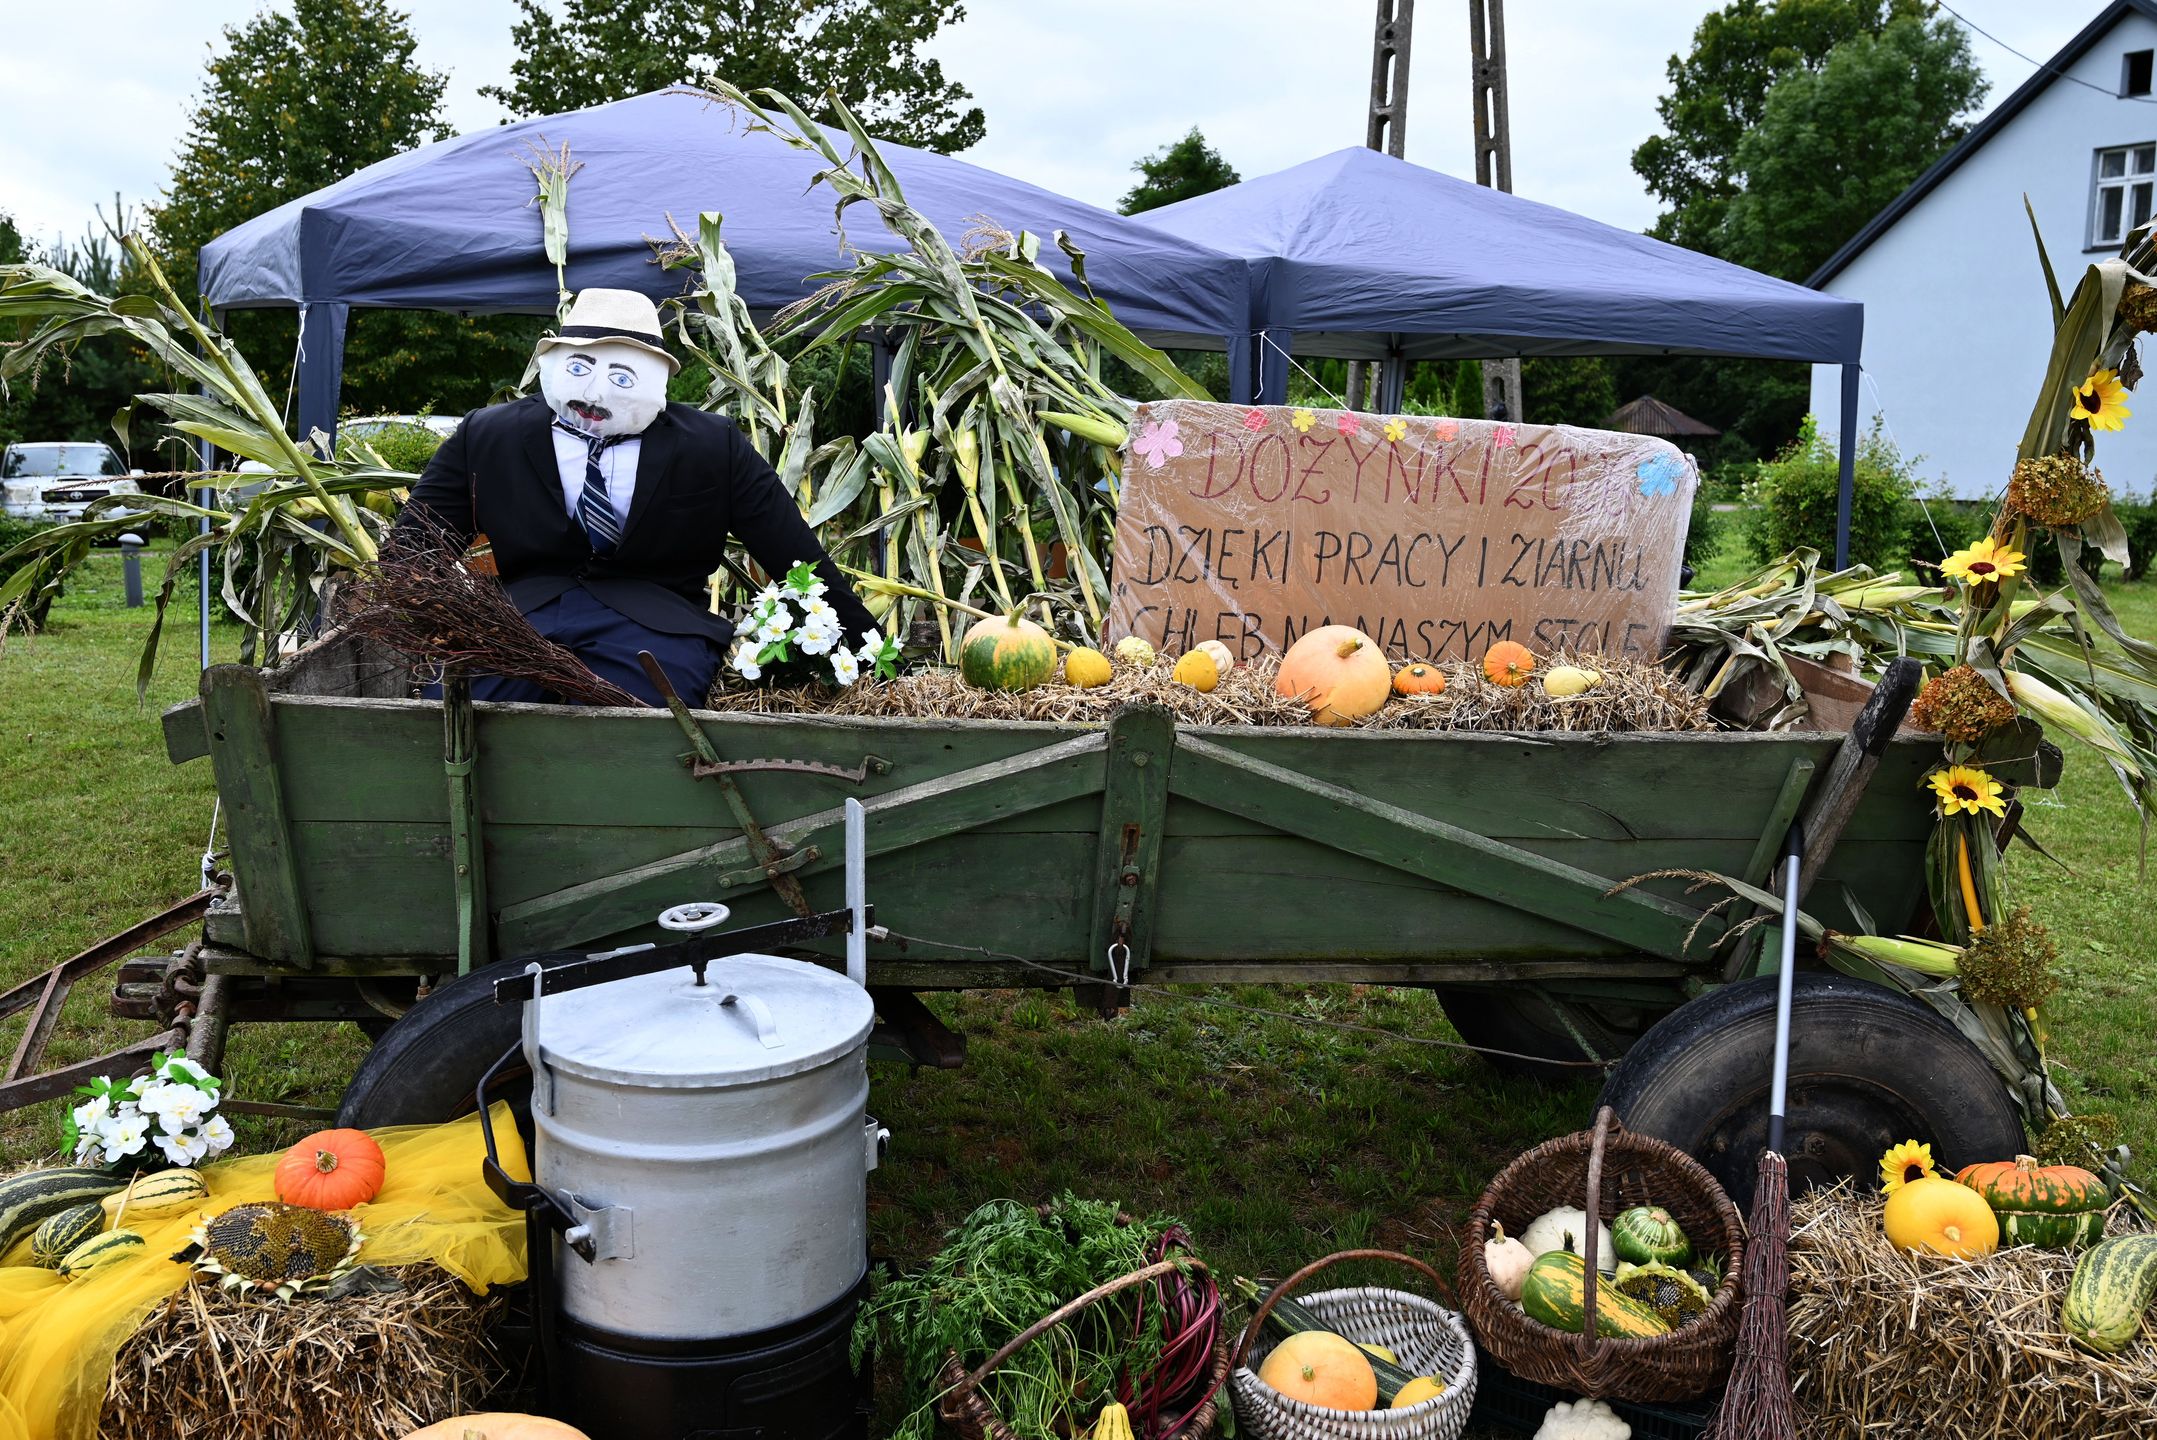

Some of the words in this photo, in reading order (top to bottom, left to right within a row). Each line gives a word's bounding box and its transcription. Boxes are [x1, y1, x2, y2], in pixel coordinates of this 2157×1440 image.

[1502, 444, 1628, 513] 20
[1314, 531, 1466, 588] PRACY
[1477, 536, 1488, 588] I
[1500, 533, 1649, 592] ZIARNU
